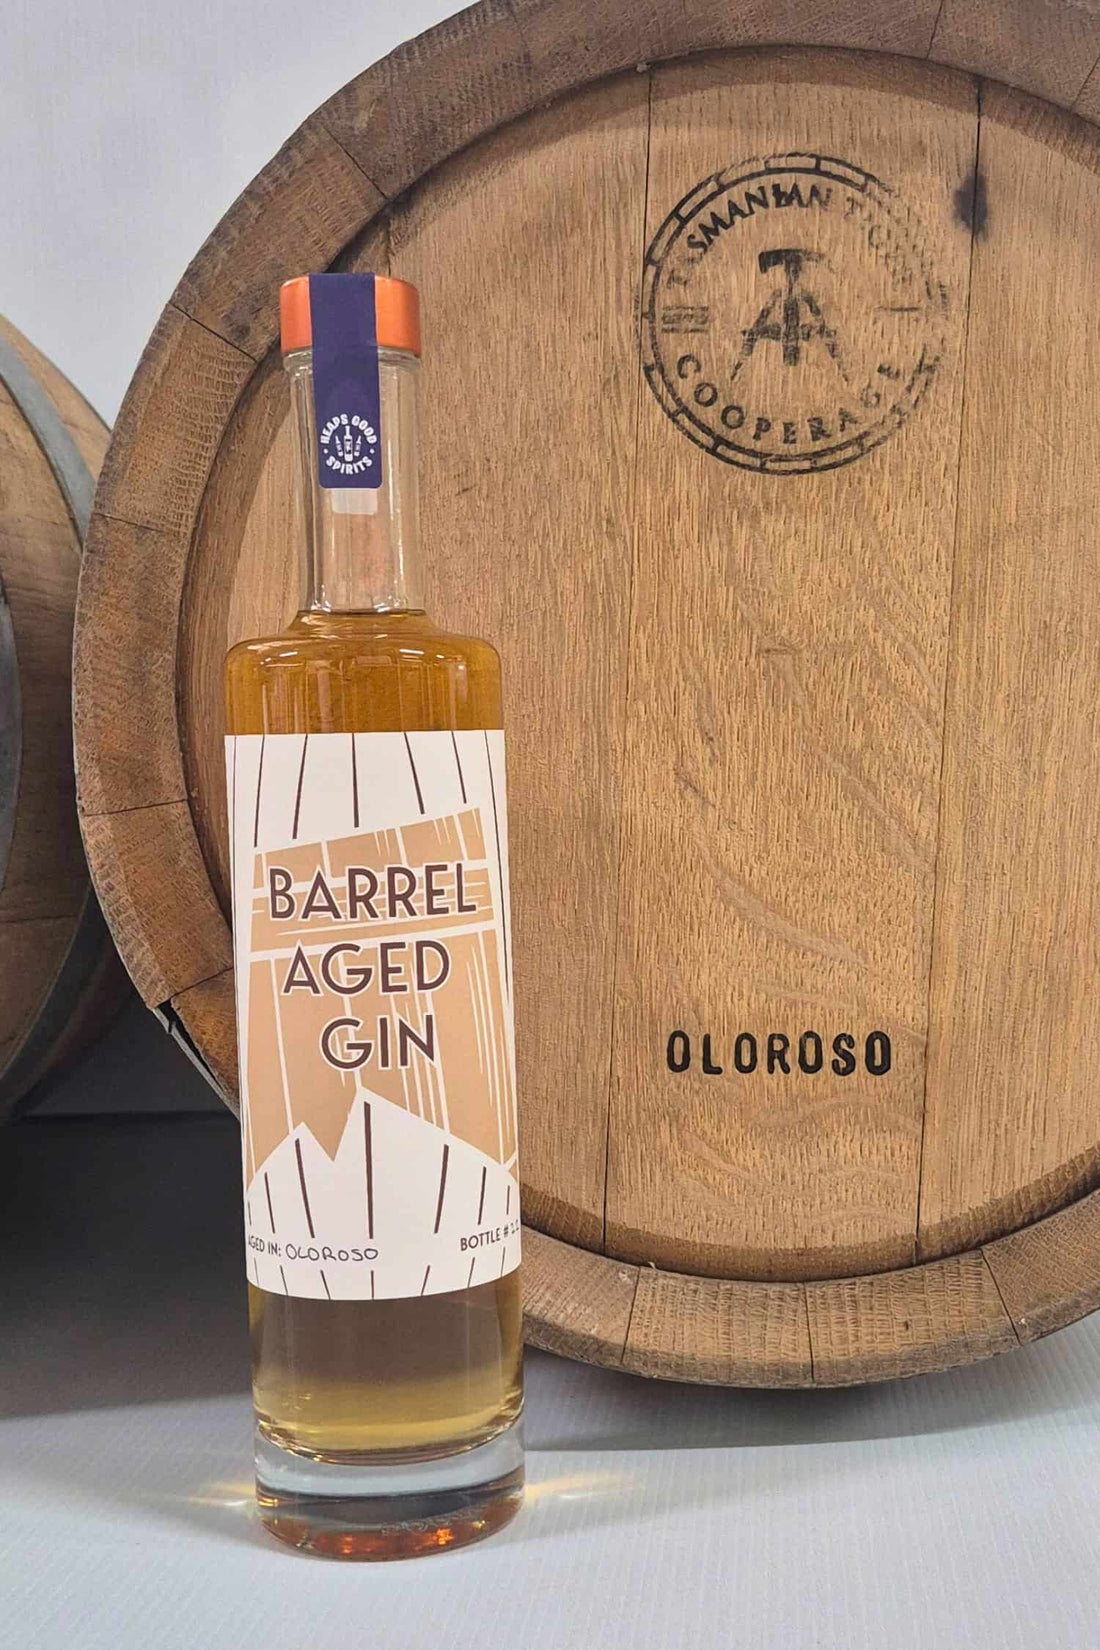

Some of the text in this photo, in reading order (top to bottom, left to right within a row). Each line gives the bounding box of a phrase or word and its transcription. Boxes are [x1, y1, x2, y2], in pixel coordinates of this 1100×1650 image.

[666, 182, 833, 290] TSMANIAN
[320, 413, 378, 444] HEAPS GOOD
[326, 455, 373, 475] SPIRITS
[269, 863, 477, 920] BARREL
[282, 940, 450, 995] AGED
[321, 1014, 435, 1070] GIN
[666, 1029, 892, 1077] OLOROSO
[268, 1241, 282, 1257] IN:
[460, 1227, 501, 1252] BOTTLE
